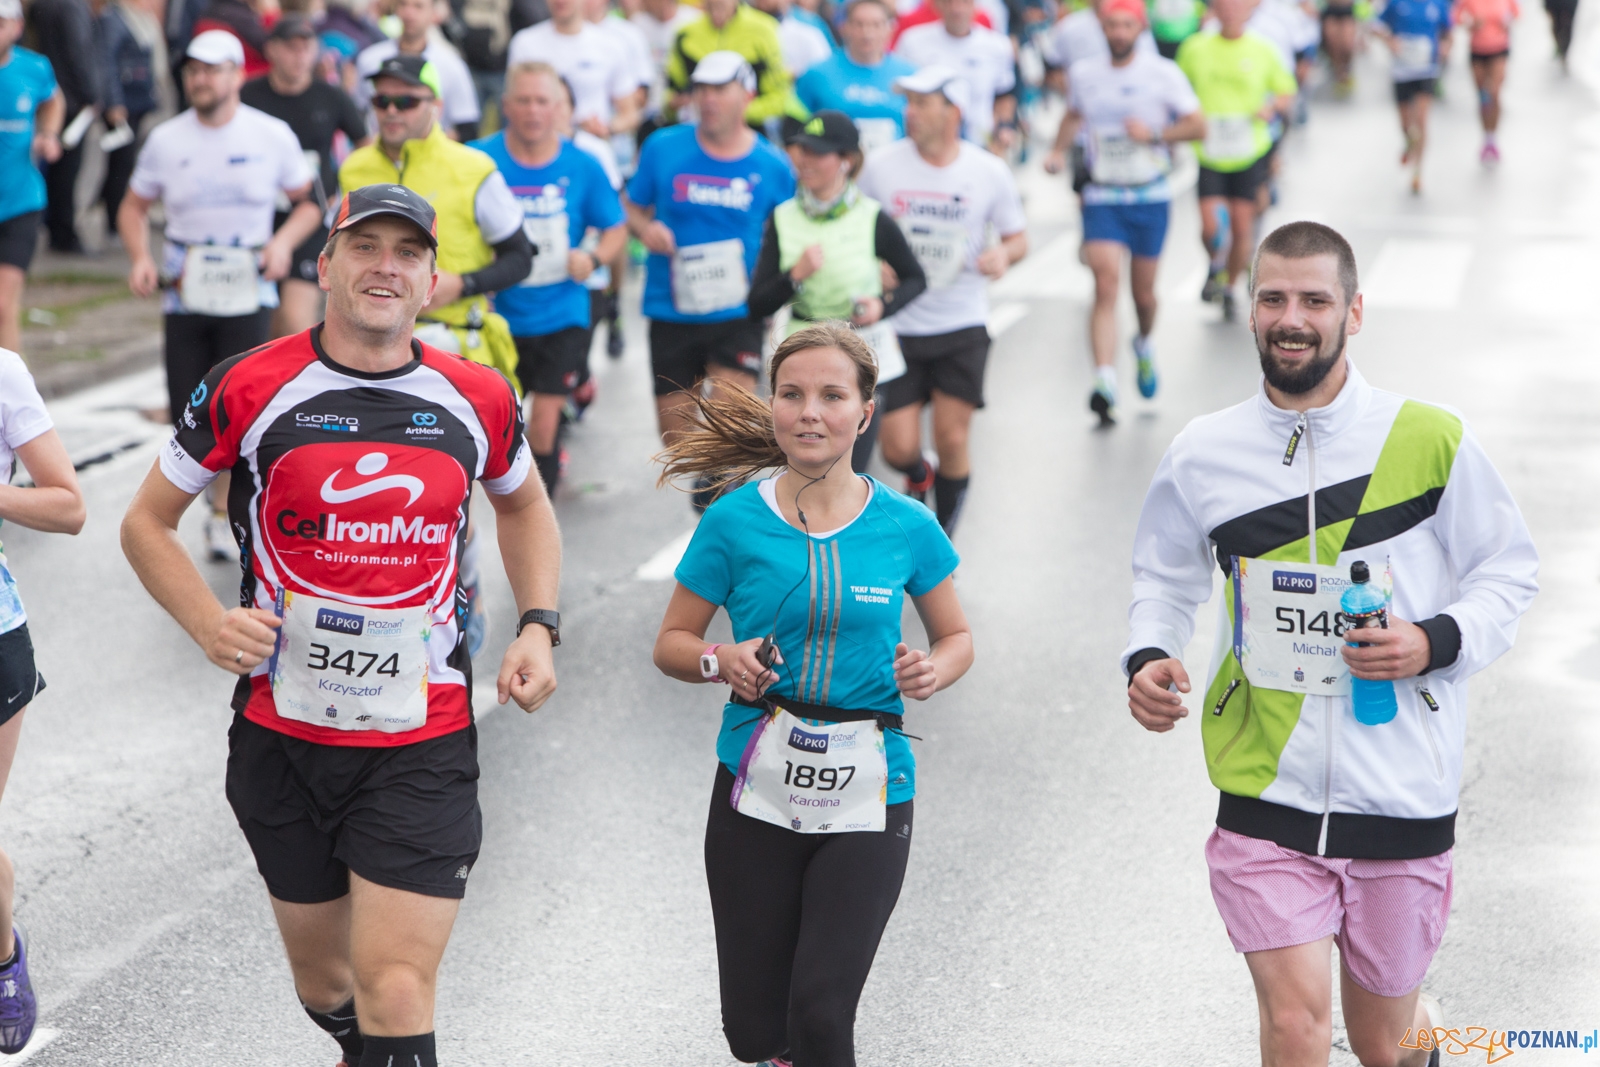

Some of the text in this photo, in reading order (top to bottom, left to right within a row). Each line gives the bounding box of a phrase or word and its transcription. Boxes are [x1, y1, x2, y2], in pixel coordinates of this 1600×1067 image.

[295, 412, 359, 425] GoPro
[405, 427, 444, 435] ArtMedia
[314, 549, 417, 567] Celironman.pl
[1276, 576, 1313, 588] 17. PKO
[1320, 577, 1351, 586] POZna
[850, 585, 893, 597] TKKF WODNIK
[321, 613, 360, 630] 17. PKO
[1275, 606, 1346, 637] 5148
[366, 627, 402, 635] maraton
[1292, 642, 1337, 657] Michał
[307, 642, 400, 678] 3474
[318, 678, 383, 697] Krzysztof
[792, 732, 827, 749] 17. PKO
[784, 760, 856, 792] 1897
[789, 793, 841, 808] Karolina
